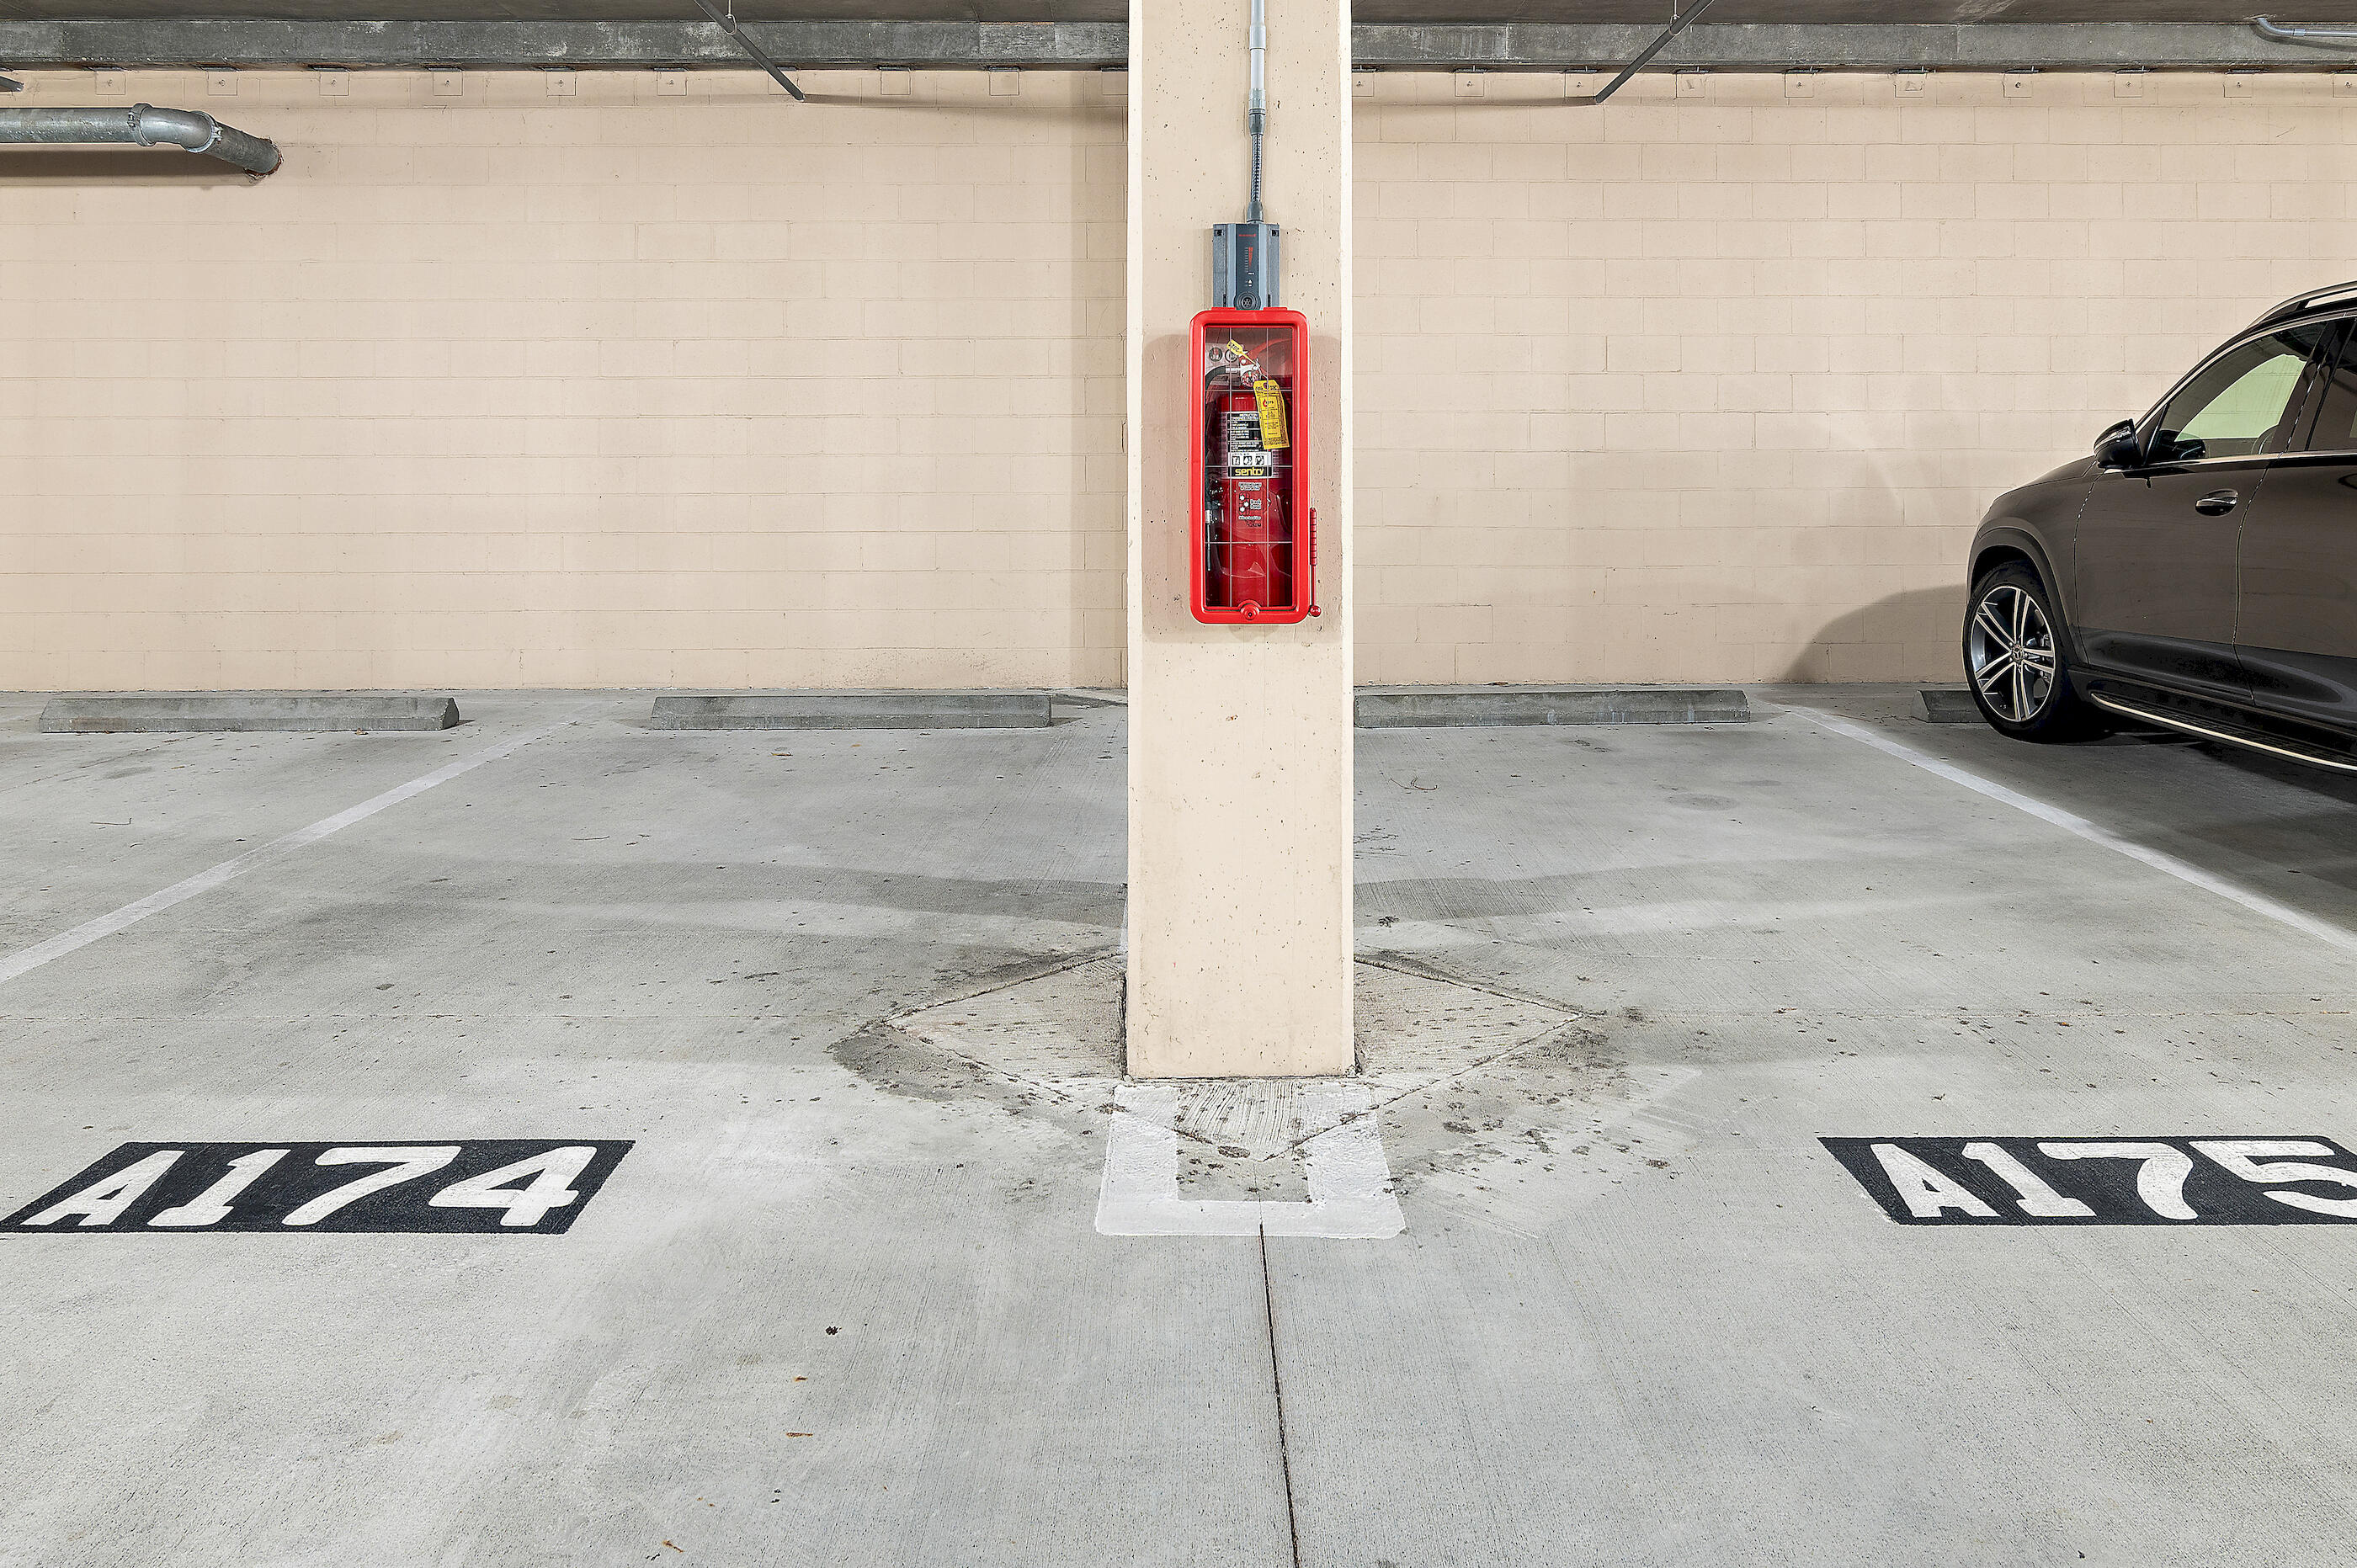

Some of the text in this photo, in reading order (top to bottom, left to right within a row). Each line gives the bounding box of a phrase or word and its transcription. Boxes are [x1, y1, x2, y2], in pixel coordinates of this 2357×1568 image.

[1235, 466, 1264, 476] sentry
[20, 1145, 597, 1227] A174
[1870, 1140, 2357, 1220] A175
